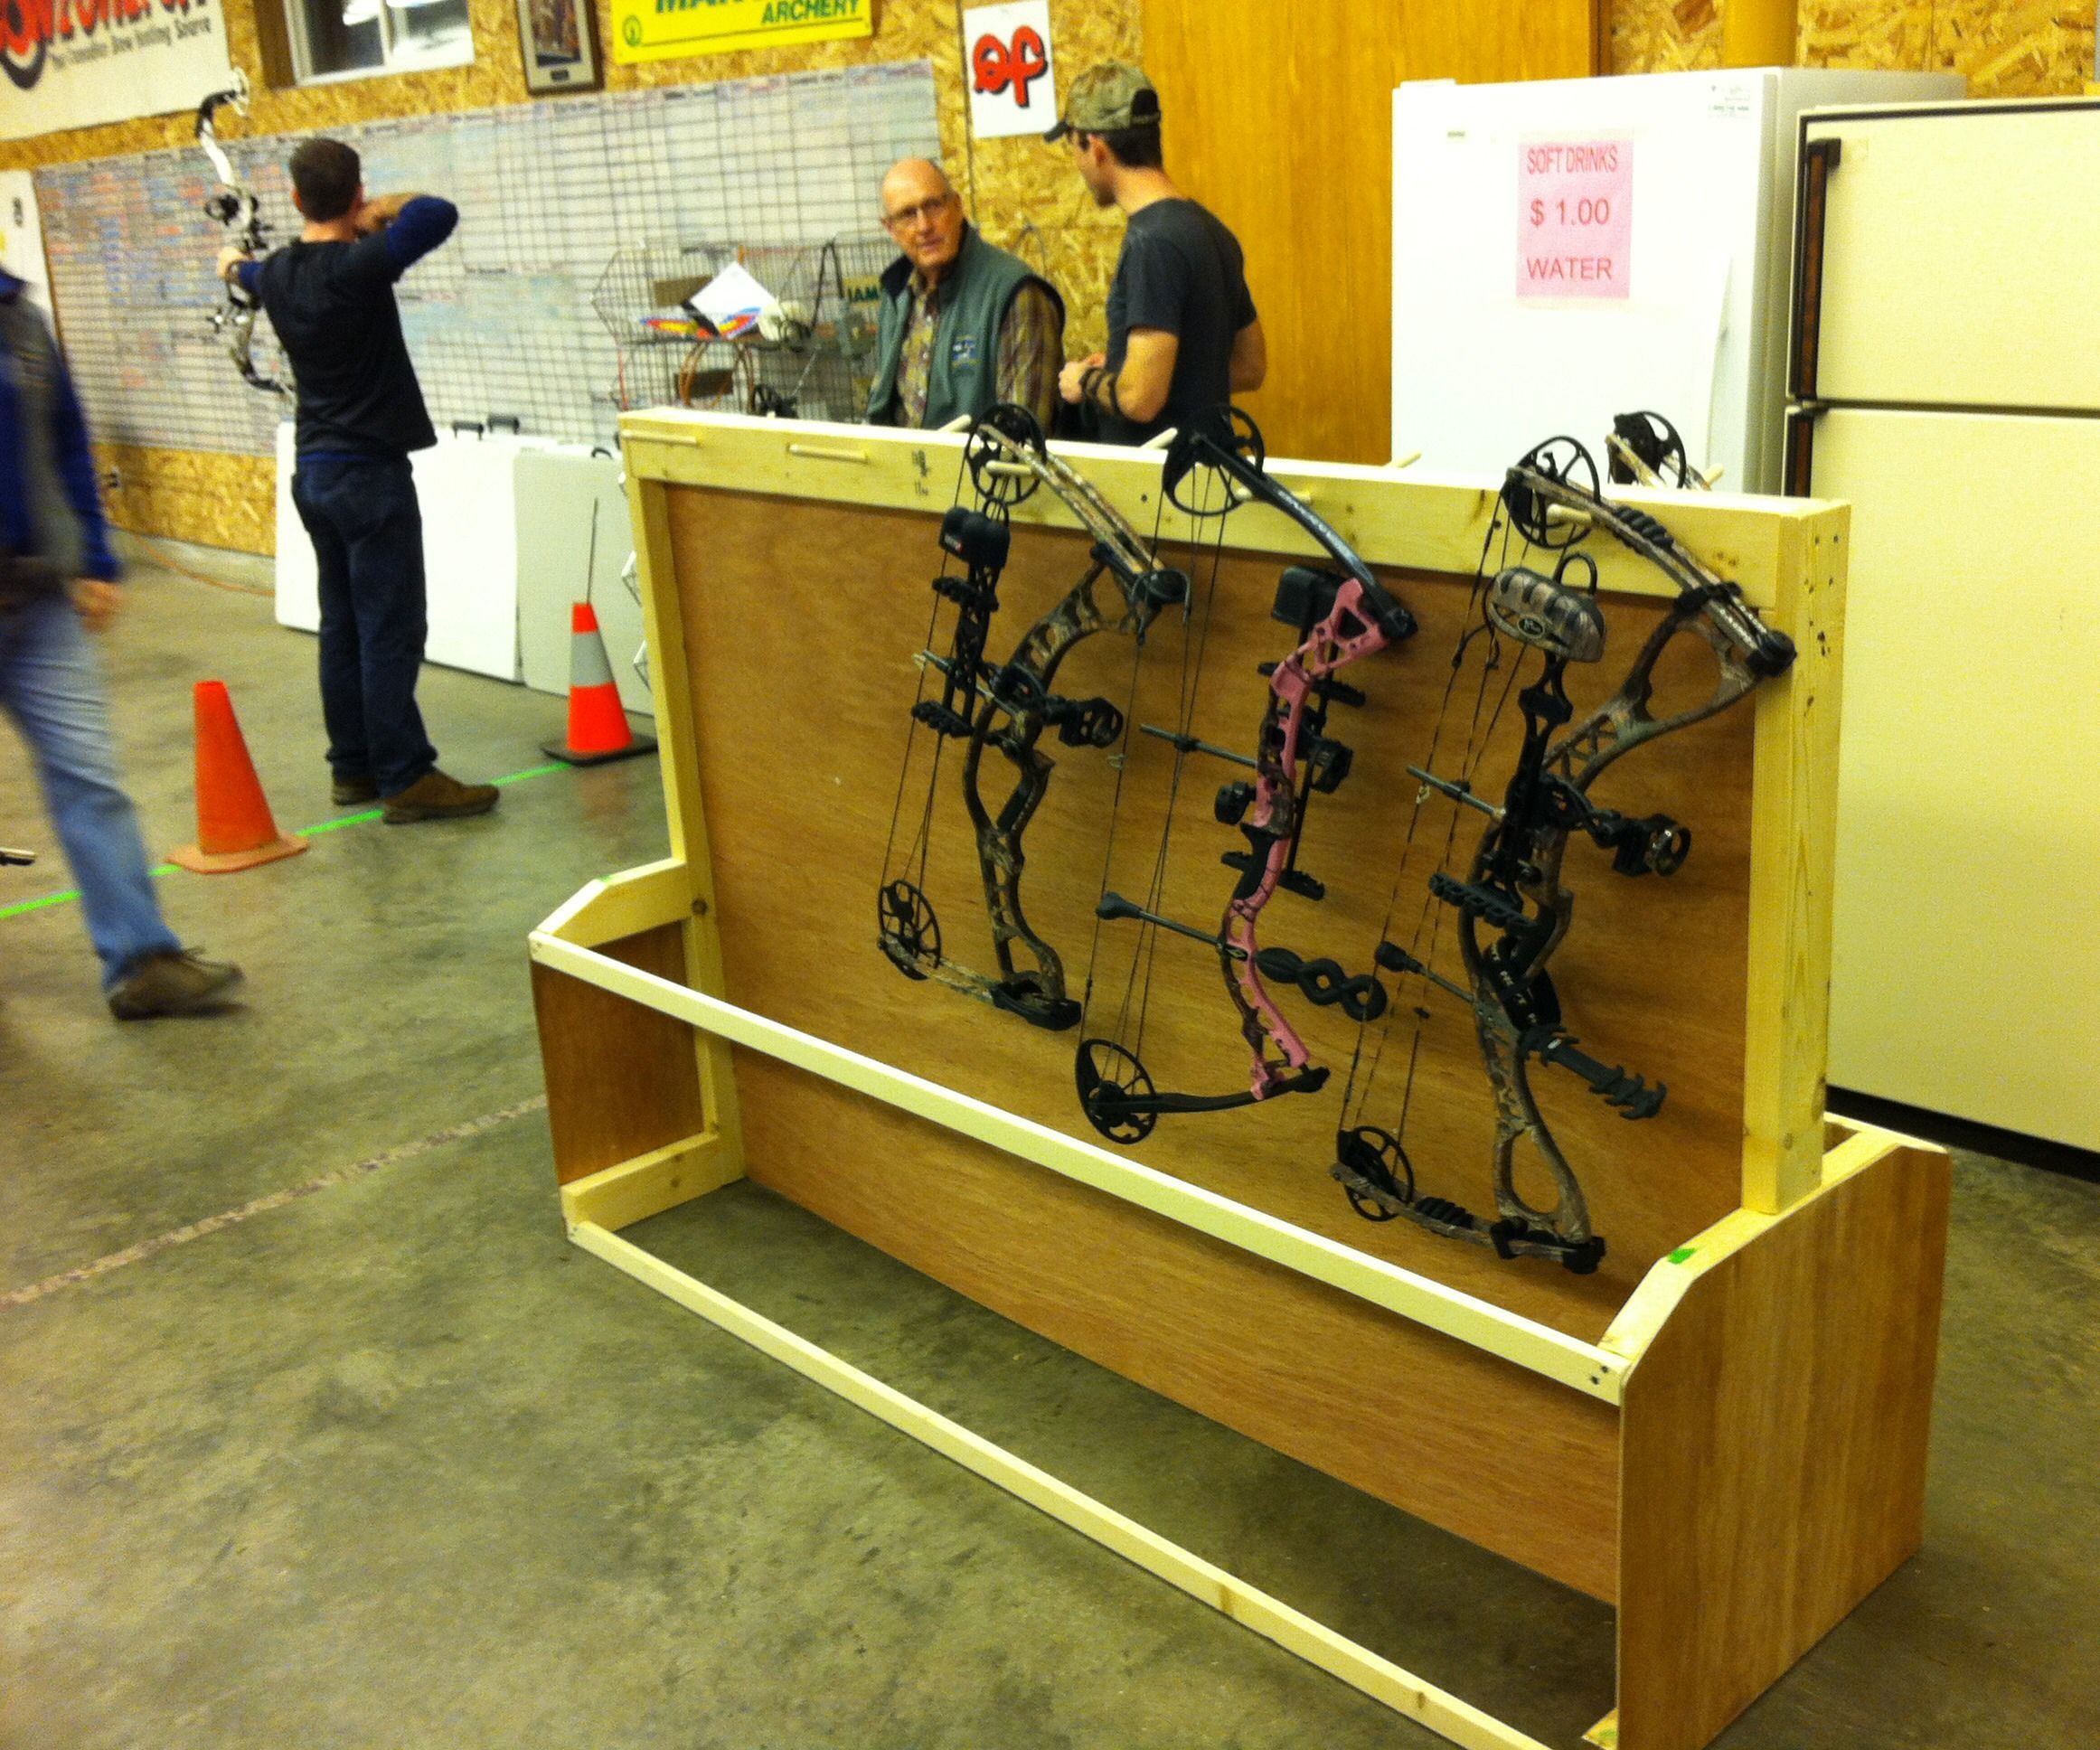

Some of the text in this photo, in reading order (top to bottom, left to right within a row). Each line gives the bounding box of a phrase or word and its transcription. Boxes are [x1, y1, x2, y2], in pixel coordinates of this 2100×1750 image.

[762, 0, 859, 24] ARCHERY
[1528, 146, 1618, 174] SOFT DRINKS
[1530, 198, 1610, 228] $ 1.00
[1527, 257, 1613, 280] WATER
